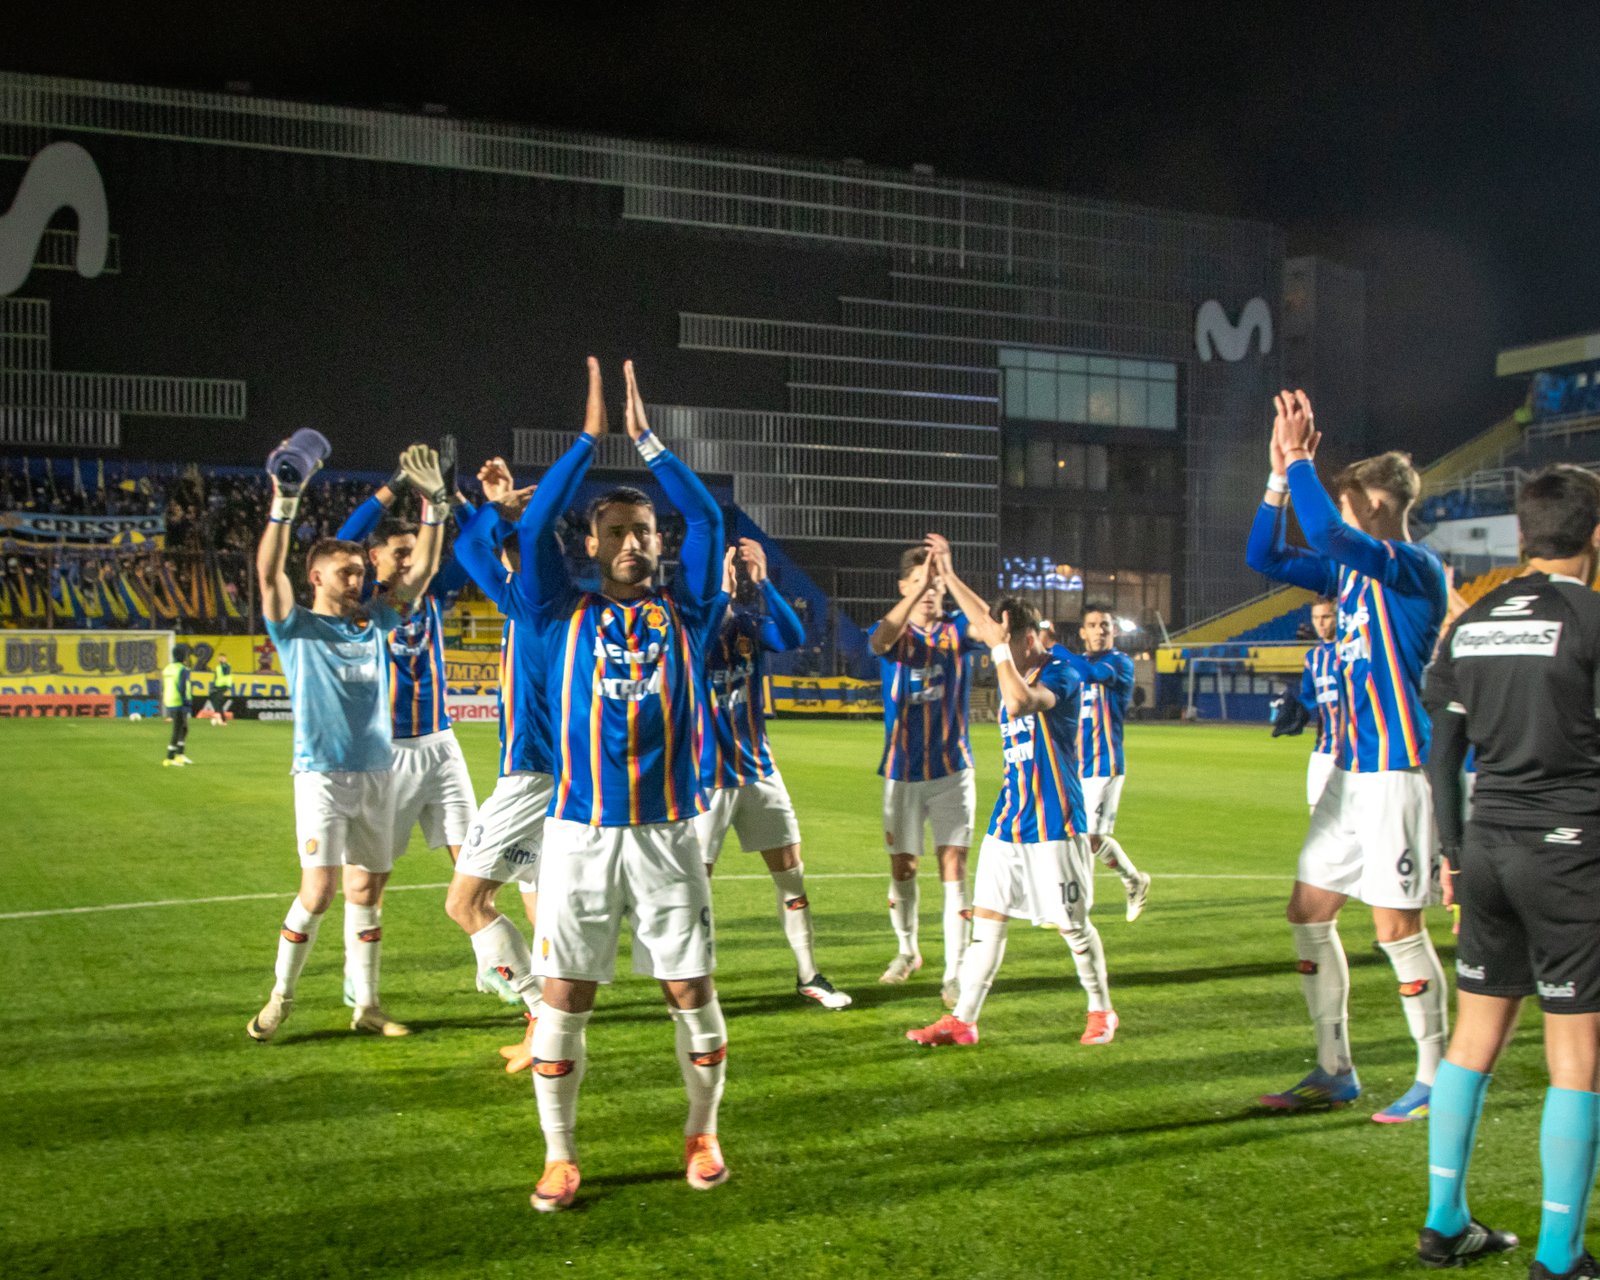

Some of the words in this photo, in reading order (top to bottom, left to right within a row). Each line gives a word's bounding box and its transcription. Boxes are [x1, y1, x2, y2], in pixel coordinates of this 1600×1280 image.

[32, 517, 159, 535] CRESPO
[5, 637, 64, 674] DEL
[77, 637, 157, 674] CLUB
[469, 825, 485, 847] 3
[1396, 849, 1413, 876] 6
[1059, 881, 1080, 905] 10
